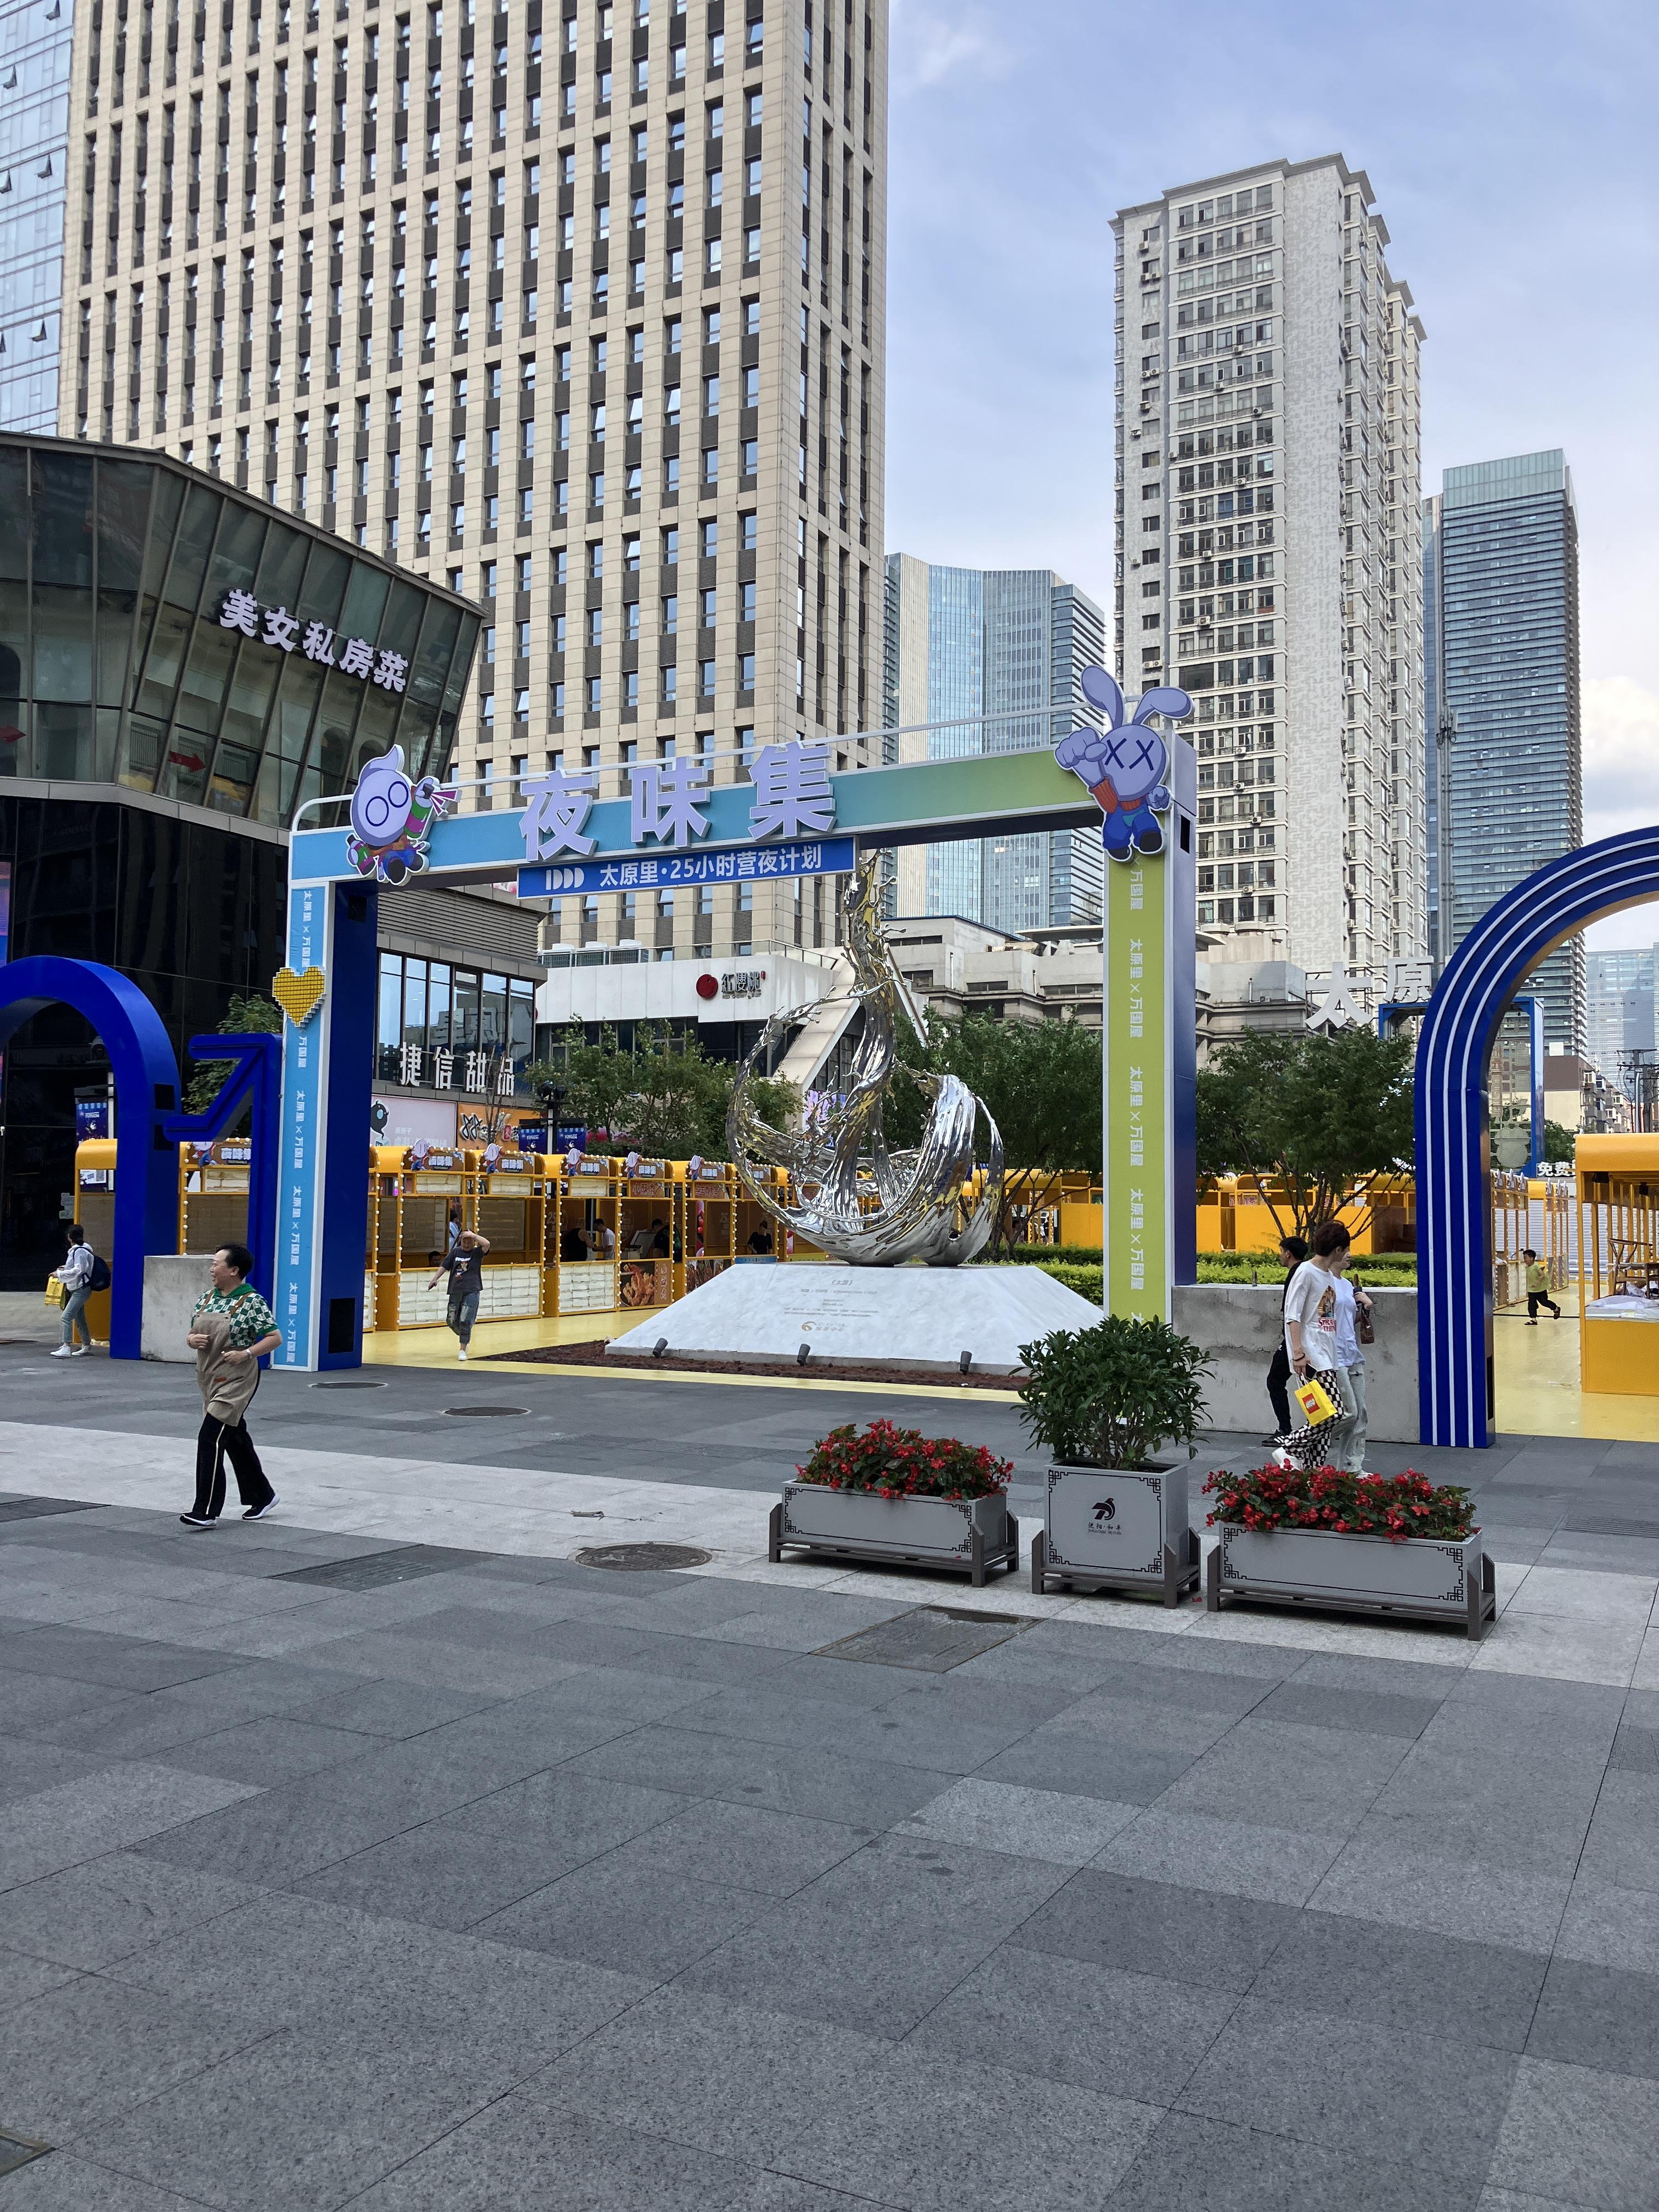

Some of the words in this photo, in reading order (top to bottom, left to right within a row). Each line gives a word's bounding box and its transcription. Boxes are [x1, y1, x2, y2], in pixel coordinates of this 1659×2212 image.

[219, 588, 409, 692] 美女私房菜
[519, 740, 837, 862] 夜味集
[399, 1041, 515, 1096] 捷信甜品
